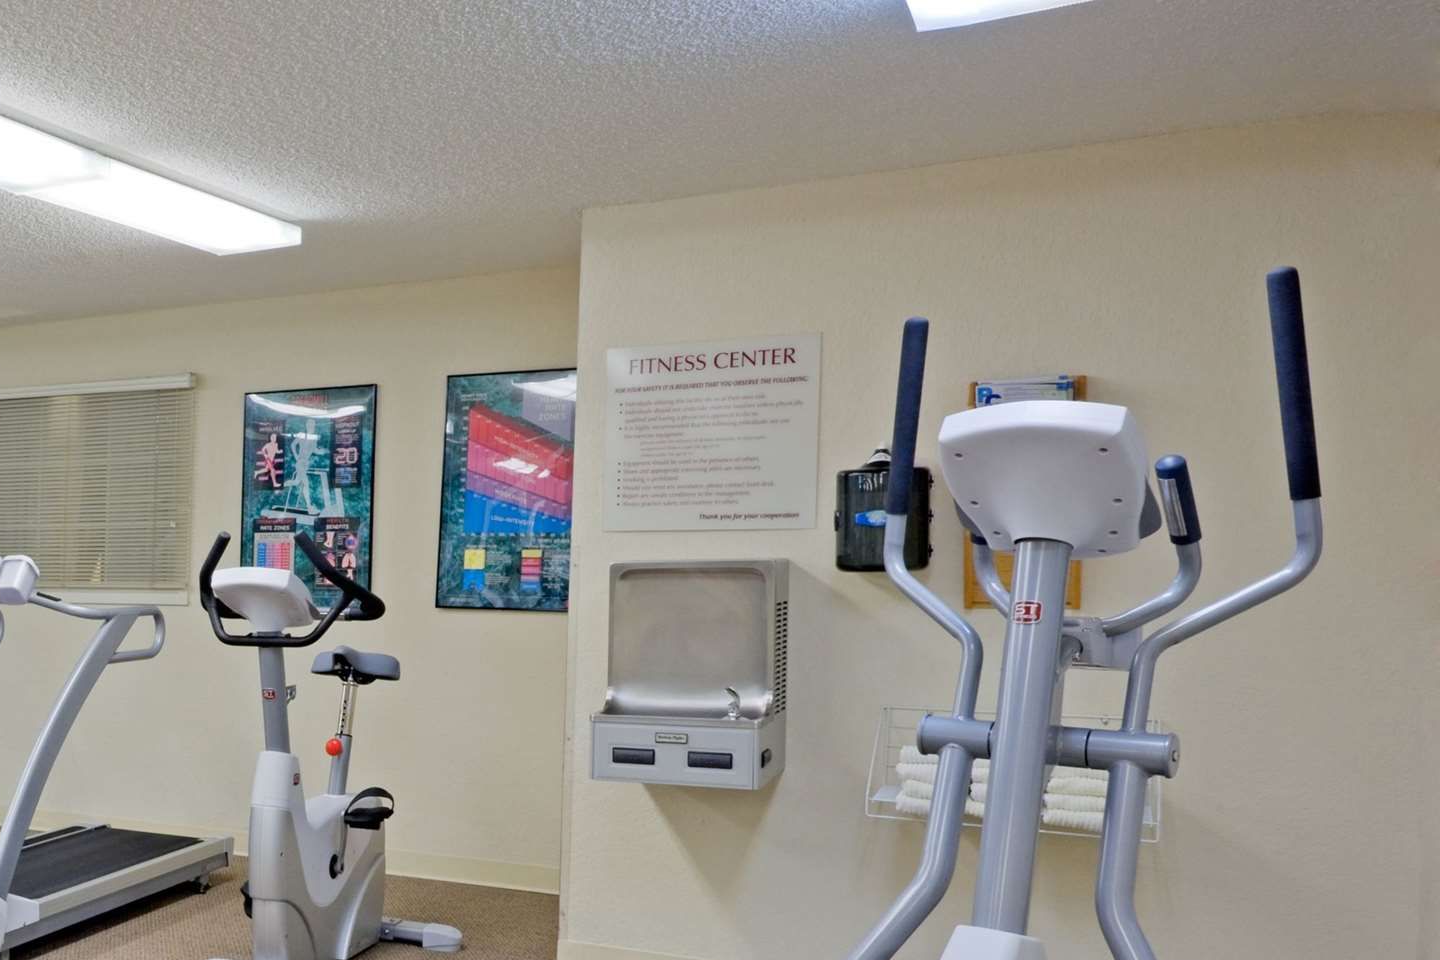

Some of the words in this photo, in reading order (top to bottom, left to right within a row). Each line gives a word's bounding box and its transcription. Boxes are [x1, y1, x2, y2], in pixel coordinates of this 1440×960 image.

[629, 353, 707, 375] FITNESS
[713, 347, 797, 370] CENTER
[720, 513, 732, 521] you
